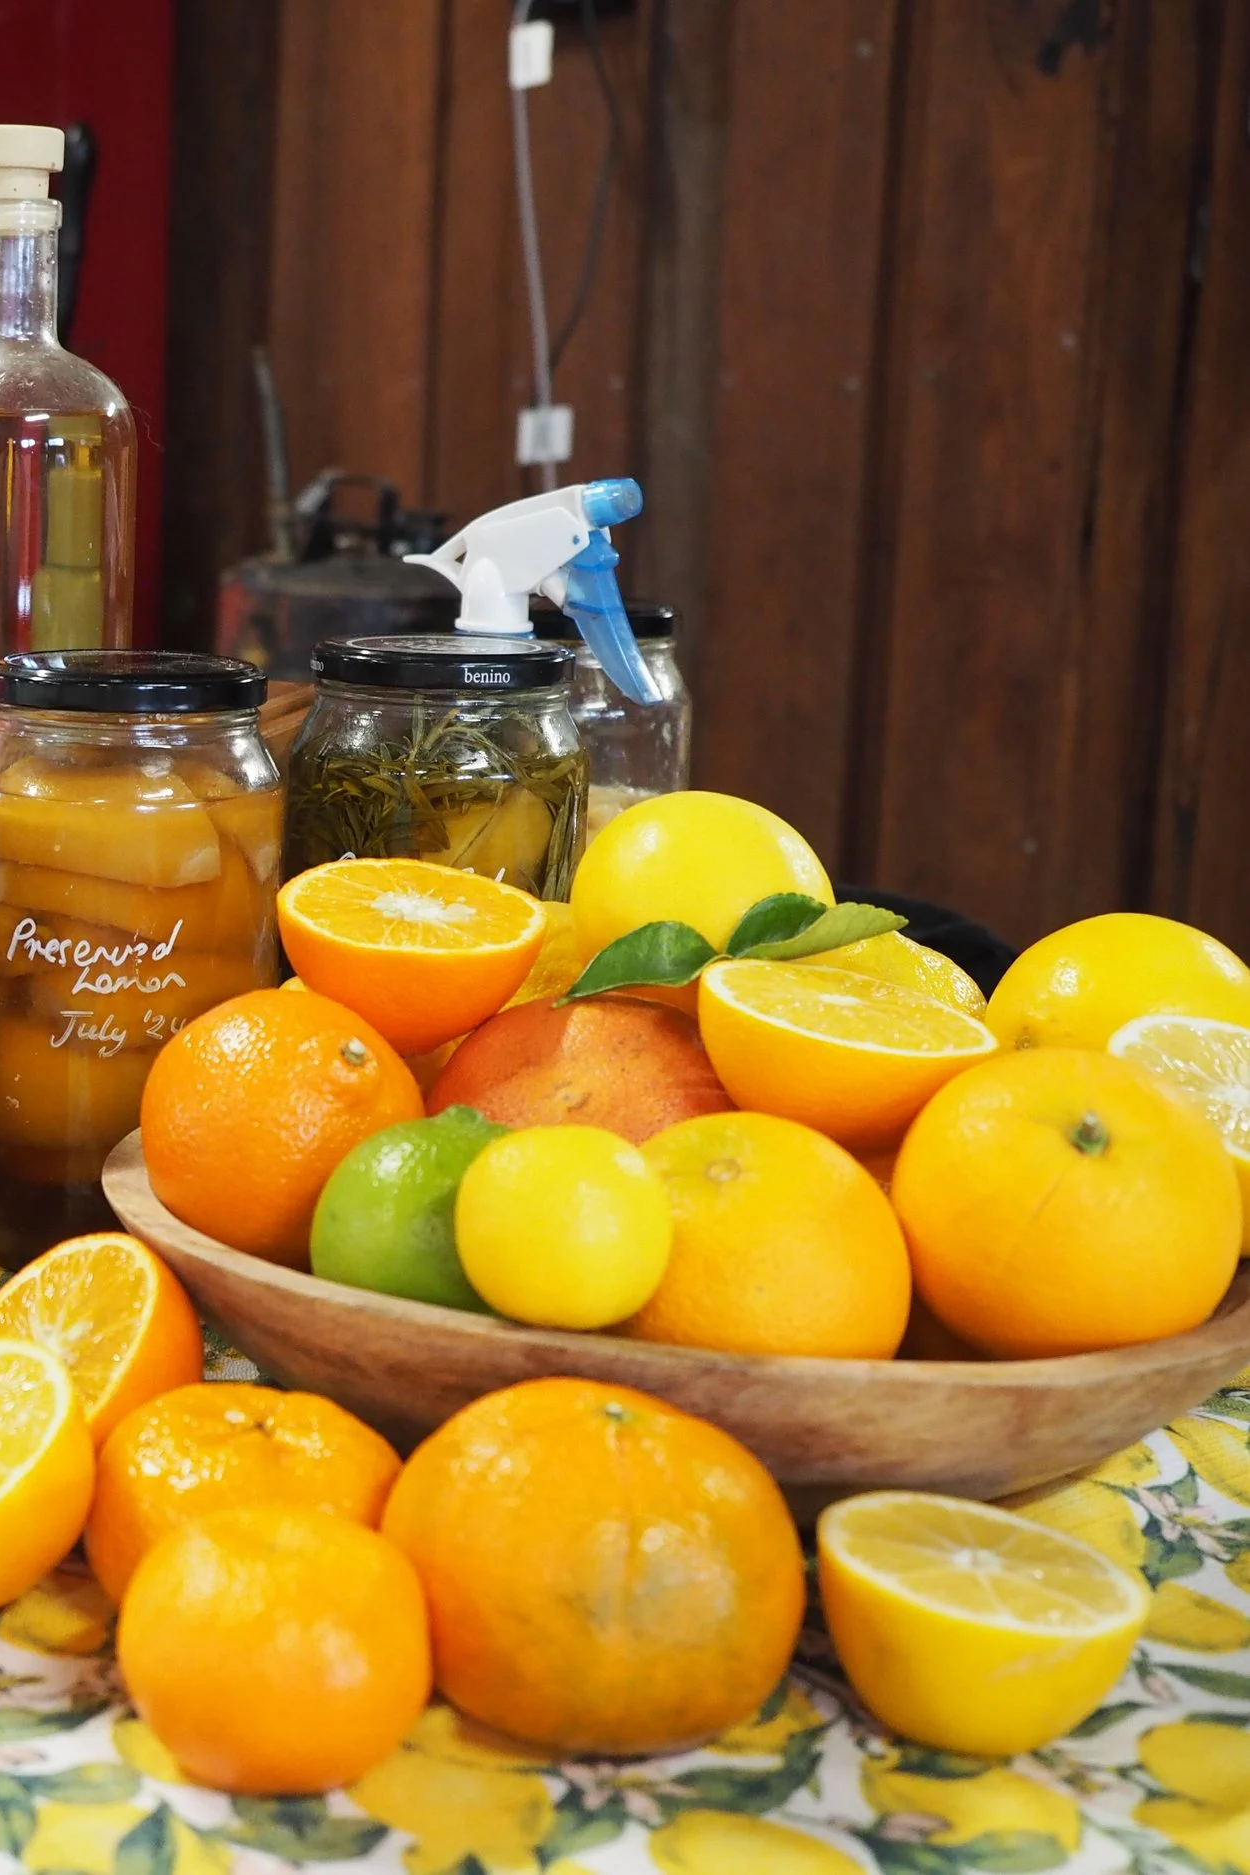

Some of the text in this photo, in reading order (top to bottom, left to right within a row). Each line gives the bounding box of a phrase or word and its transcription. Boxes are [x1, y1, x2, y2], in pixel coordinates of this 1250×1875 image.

[464, 668, 511, 684] benino
[7, 917, 183, 968] Preserved
[71, 967, 186, 995] Lemon
[51, 1010, 127, 1057] July
